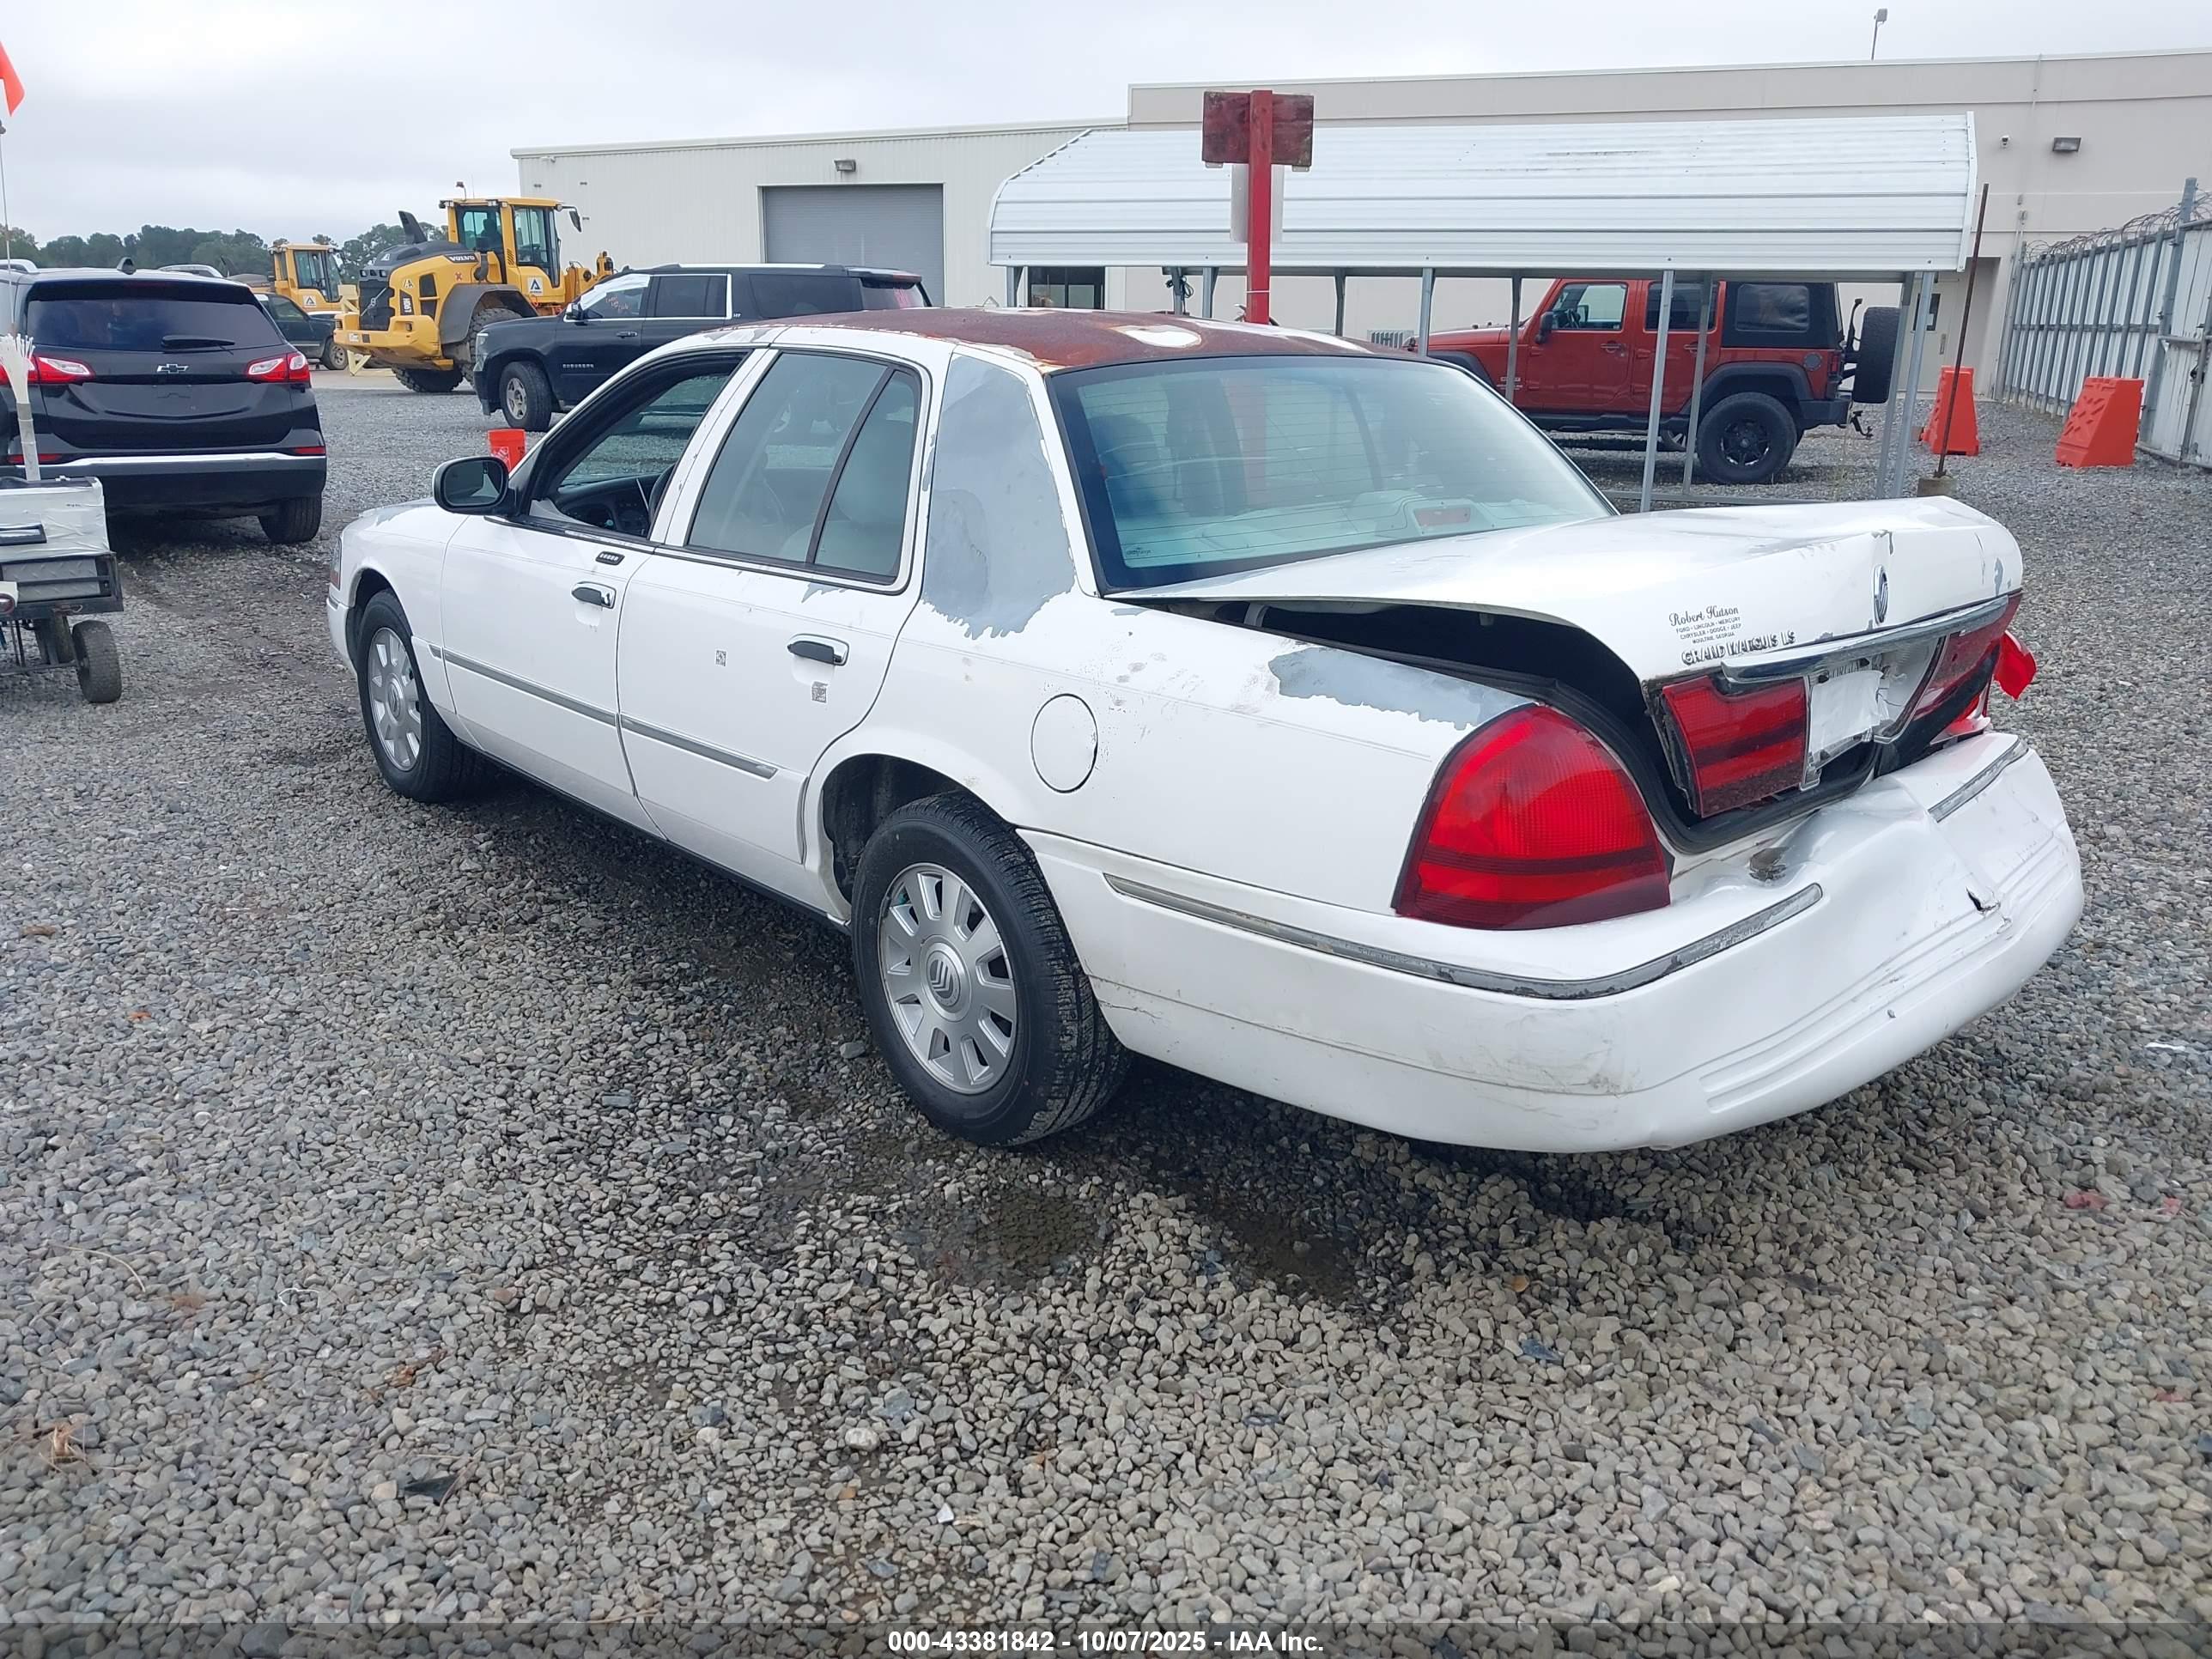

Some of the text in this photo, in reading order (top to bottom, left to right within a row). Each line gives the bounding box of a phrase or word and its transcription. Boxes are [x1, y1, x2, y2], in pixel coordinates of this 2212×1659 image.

[1668, 605, 1739, 627] Robert Hutson
[1676, 617, 1741, 635] FORD LINCOLN MERCURY
[1680, 629, 1706, 640] CHRYSLER
[1710, 625, 1727, 635] DODGE
[1715, 631, 1735, 640] GEORGIA
[1681, 630, 1796, 665] GRAND MARQUIS LS
